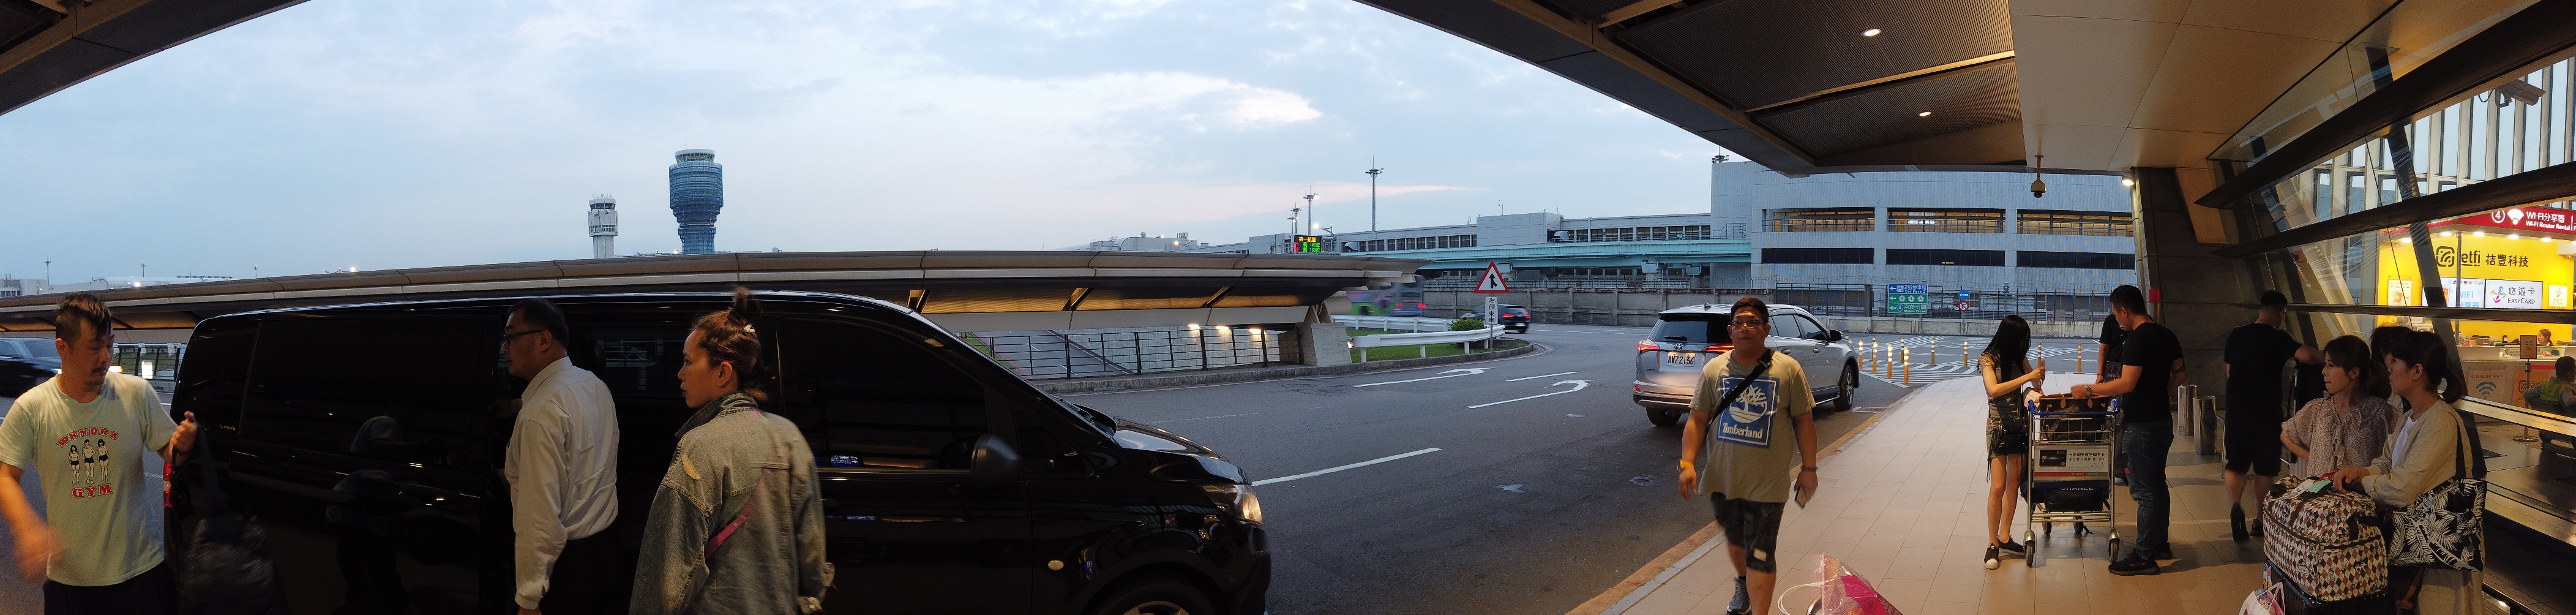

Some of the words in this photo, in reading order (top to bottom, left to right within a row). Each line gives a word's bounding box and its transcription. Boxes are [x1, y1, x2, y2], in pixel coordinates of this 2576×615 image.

[2461, 251, 2481, 265] etfi
[2508, 286, 2536, 296] 悠遊卡
[56, 427, 119, 448] WKNDRS
[1723, 422, 1763, 439] Timberland
[72, 483, 114, 499] GYM
